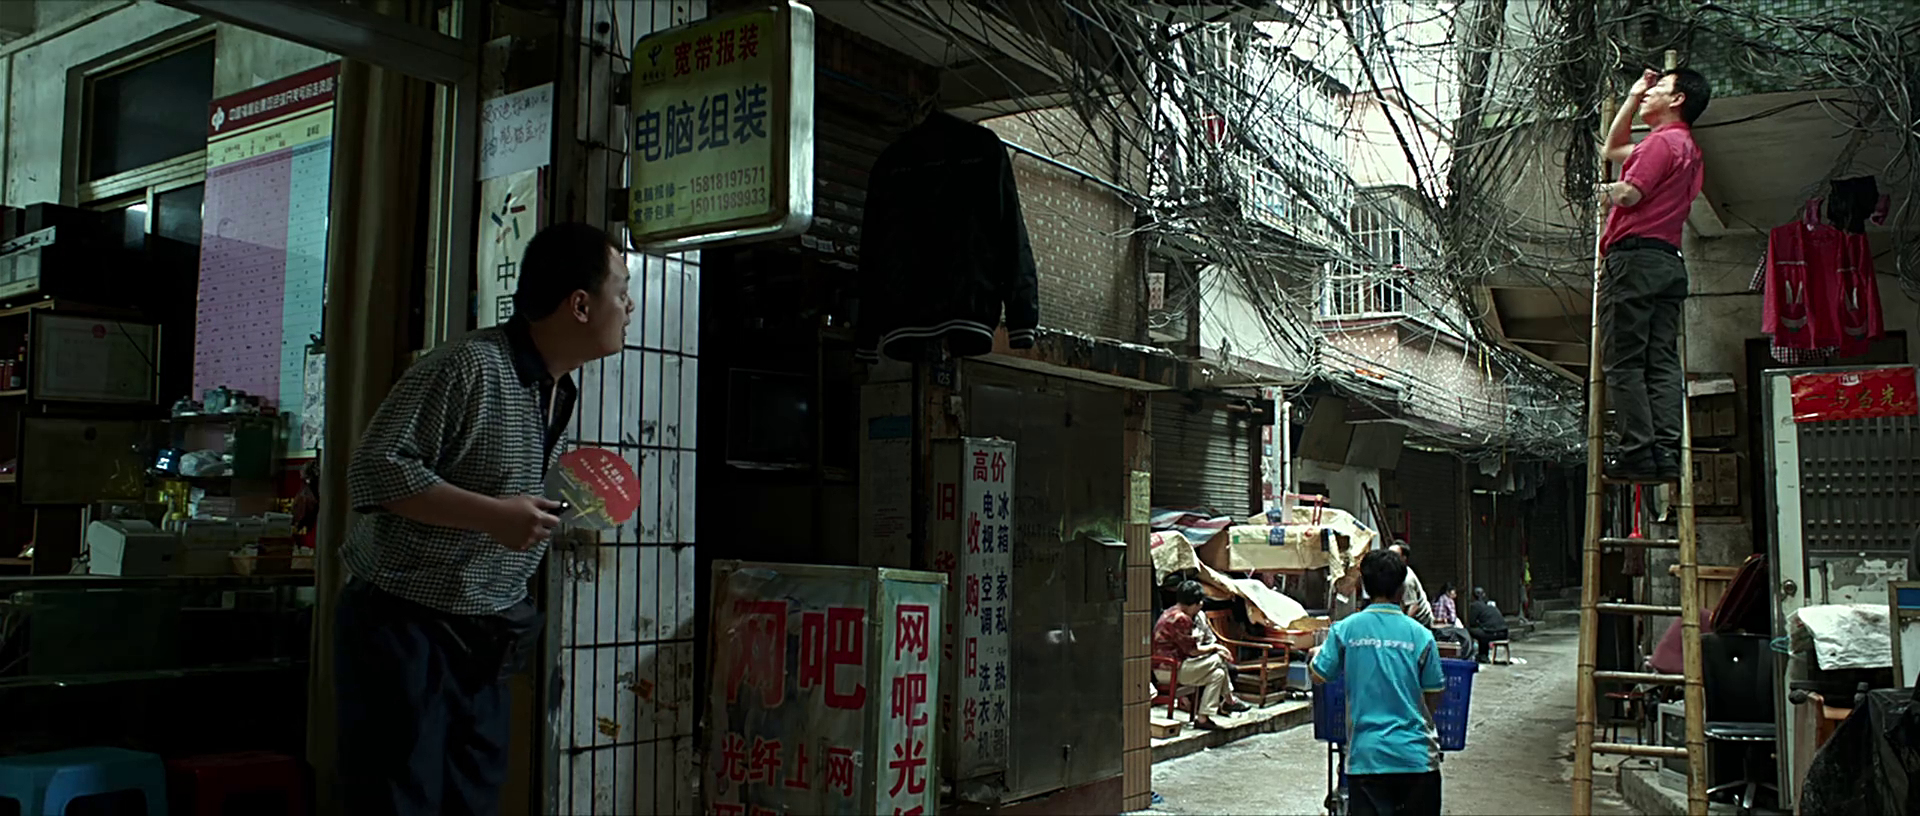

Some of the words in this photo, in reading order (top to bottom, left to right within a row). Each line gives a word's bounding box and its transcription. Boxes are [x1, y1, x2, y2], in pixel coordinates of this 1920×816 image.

[673, 23, 760, 78] 宽带报装
[634, 83, 767, 162] 电脑组装
[1804, 383, 1904, 410] 一马当先
[972, 450, 1007, 484] 高价
[727, 600, 867, 710] 网吧
[715, 733, 855, 798] 光纤上网
